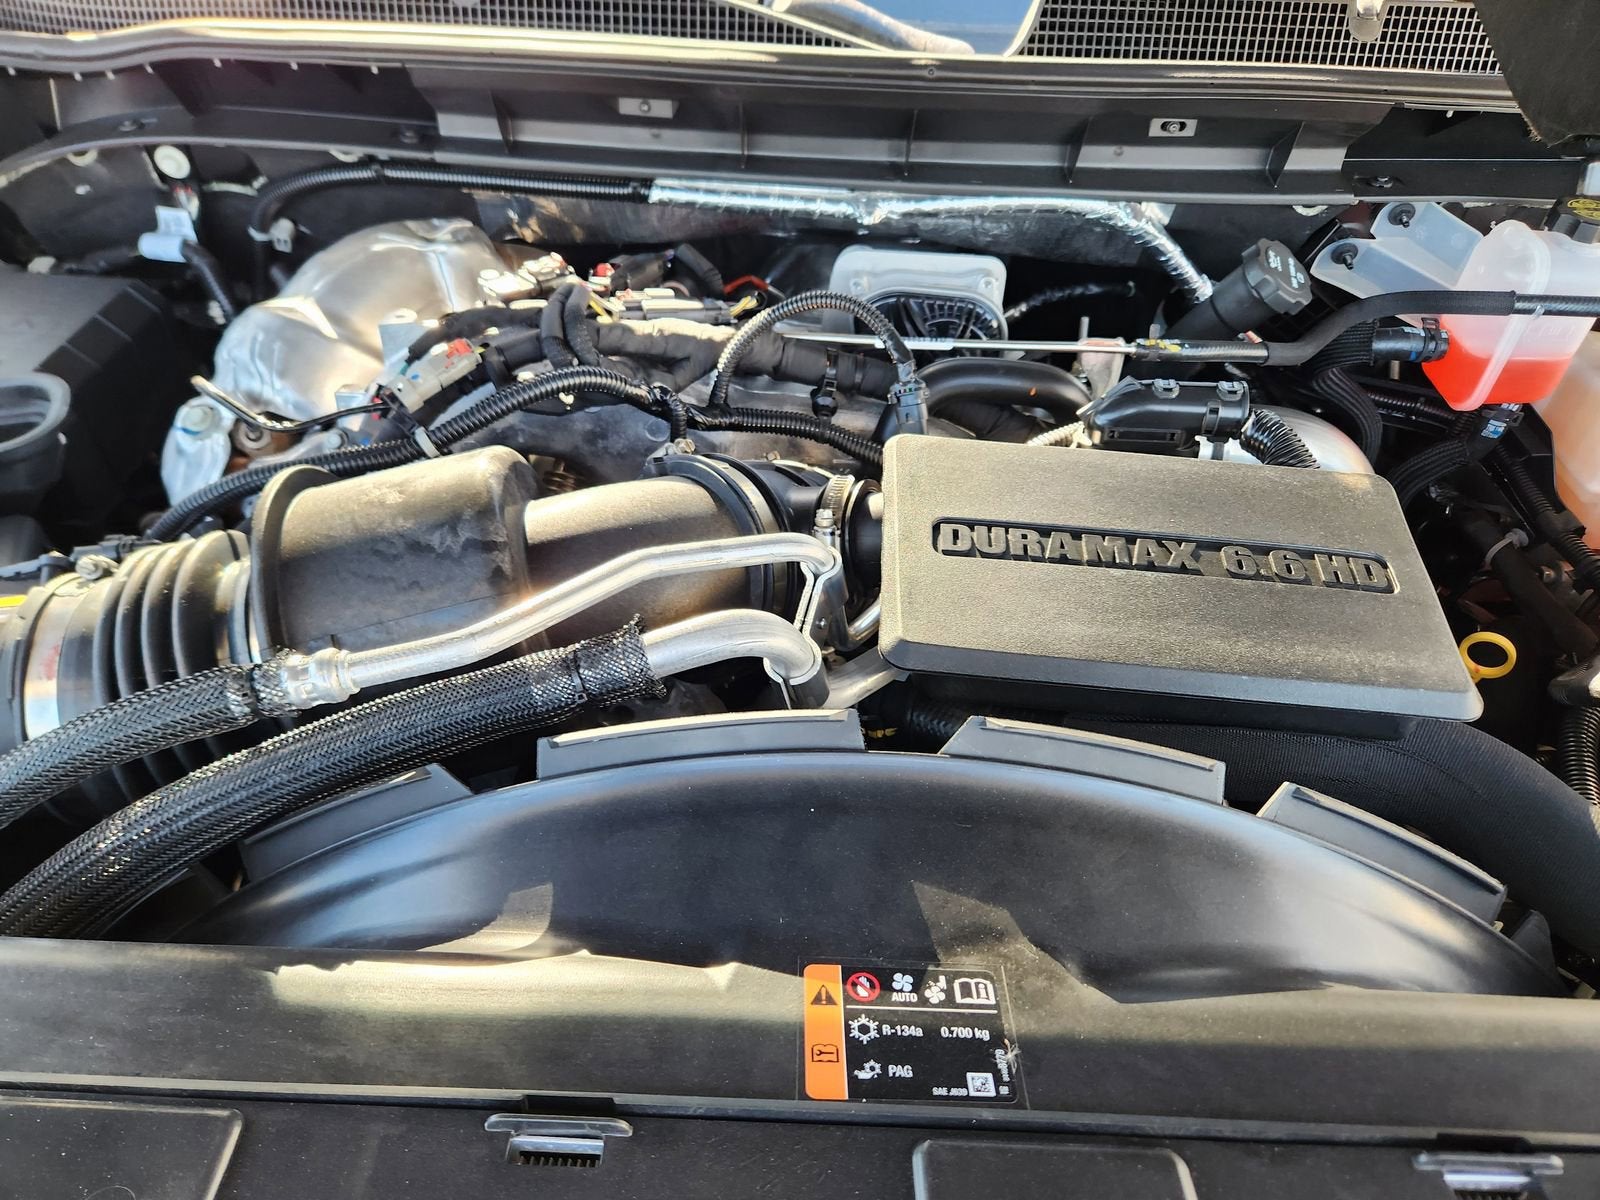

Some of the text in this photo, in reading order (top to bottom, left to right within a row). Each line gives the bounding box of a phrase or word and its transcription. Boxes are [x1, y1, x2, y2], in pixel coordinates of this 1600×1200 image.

[936, 521, 1391, 589] DURAMAX 6.6 HD
[891, 992, 918, 1003] AUTO
[881, 1025, 991, 1042] R-134a 0.700 kg
[888, 1064, 914, 1078] PAG
[932, 1086, 949, 1096] SAE
